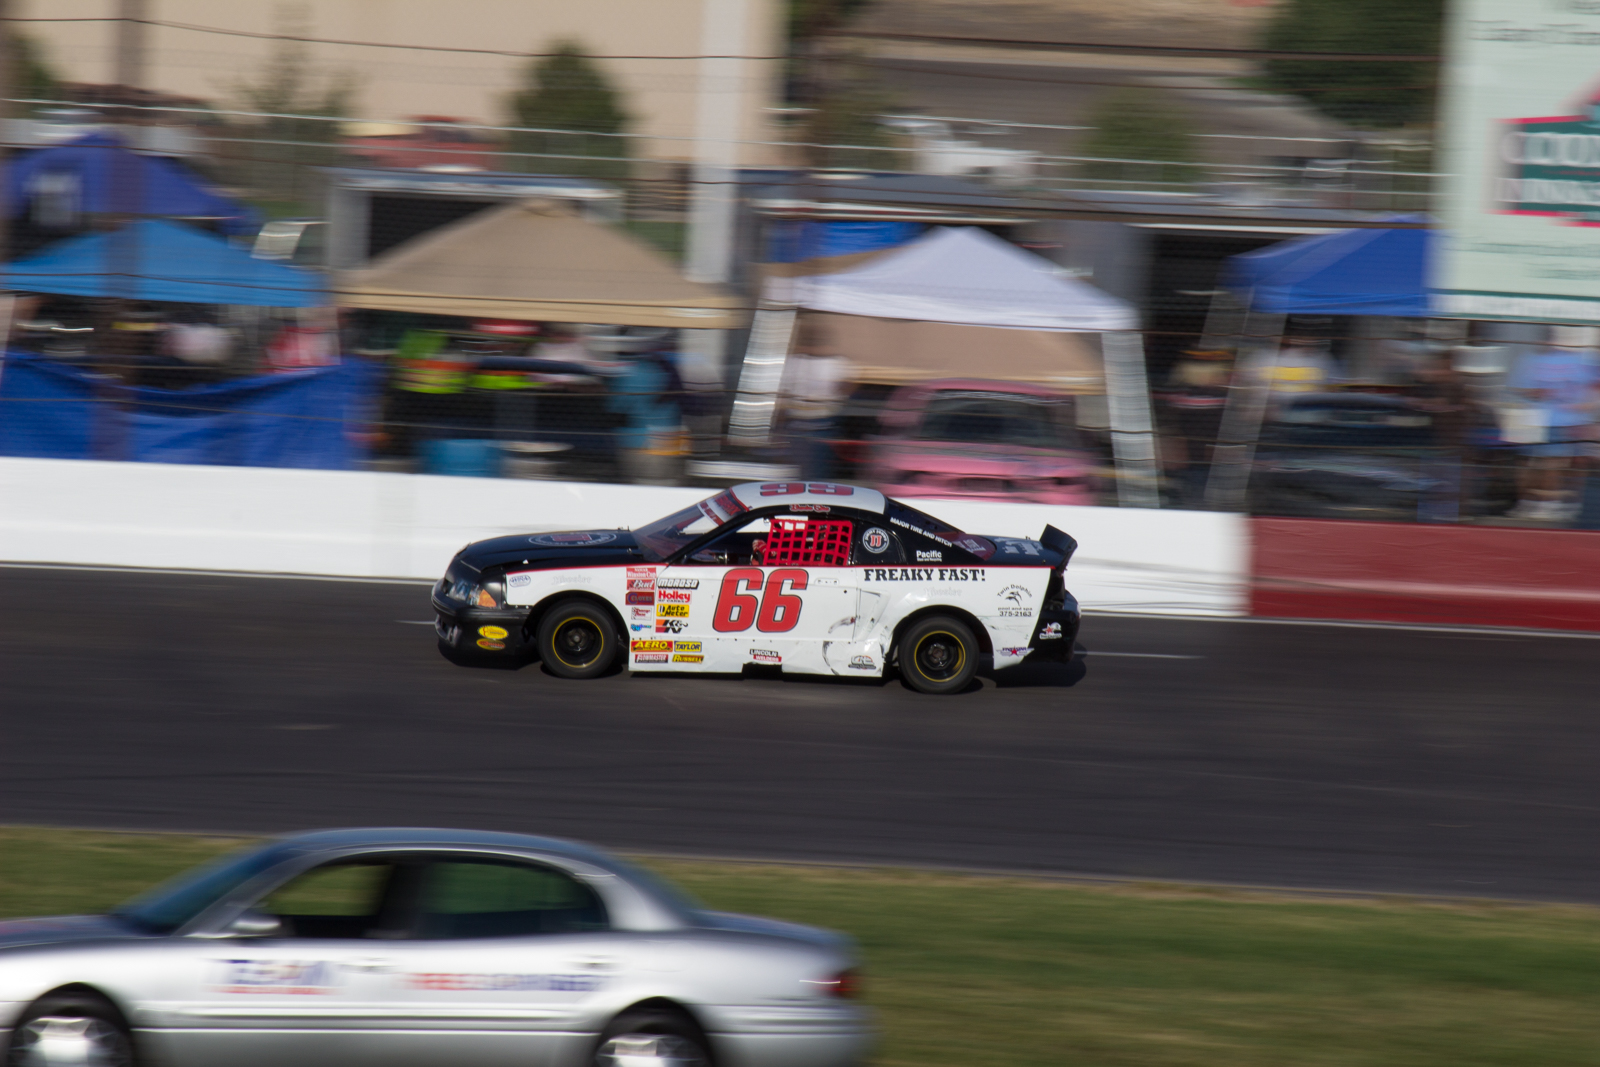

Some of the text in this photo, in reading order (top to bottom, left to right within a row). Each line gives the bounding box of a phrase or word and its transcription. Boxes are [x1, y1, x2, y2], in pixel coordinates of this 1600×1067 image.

[890, 517, 910, 530] MAJOR
[910, 524, 923, 535] TIRE
[923, 530, 936, 540] AND
[936, 534, 953, 548] HITCH
[916, 550, 942, 559] Pacific
[864, 569, 985, 581] FREAKY FAST!
[657, 578, 699, 590] MOROSO
[658, 590, 691, 603] Holley
[997, 584, 1033, 598] Twin Dolphin
[712, 568, 809, 633] 66
[634, 641, 669, 650] AERO
[676, 643, 701, 651] TAYLOR
[750, 649, 779, 657] LINCOLN
